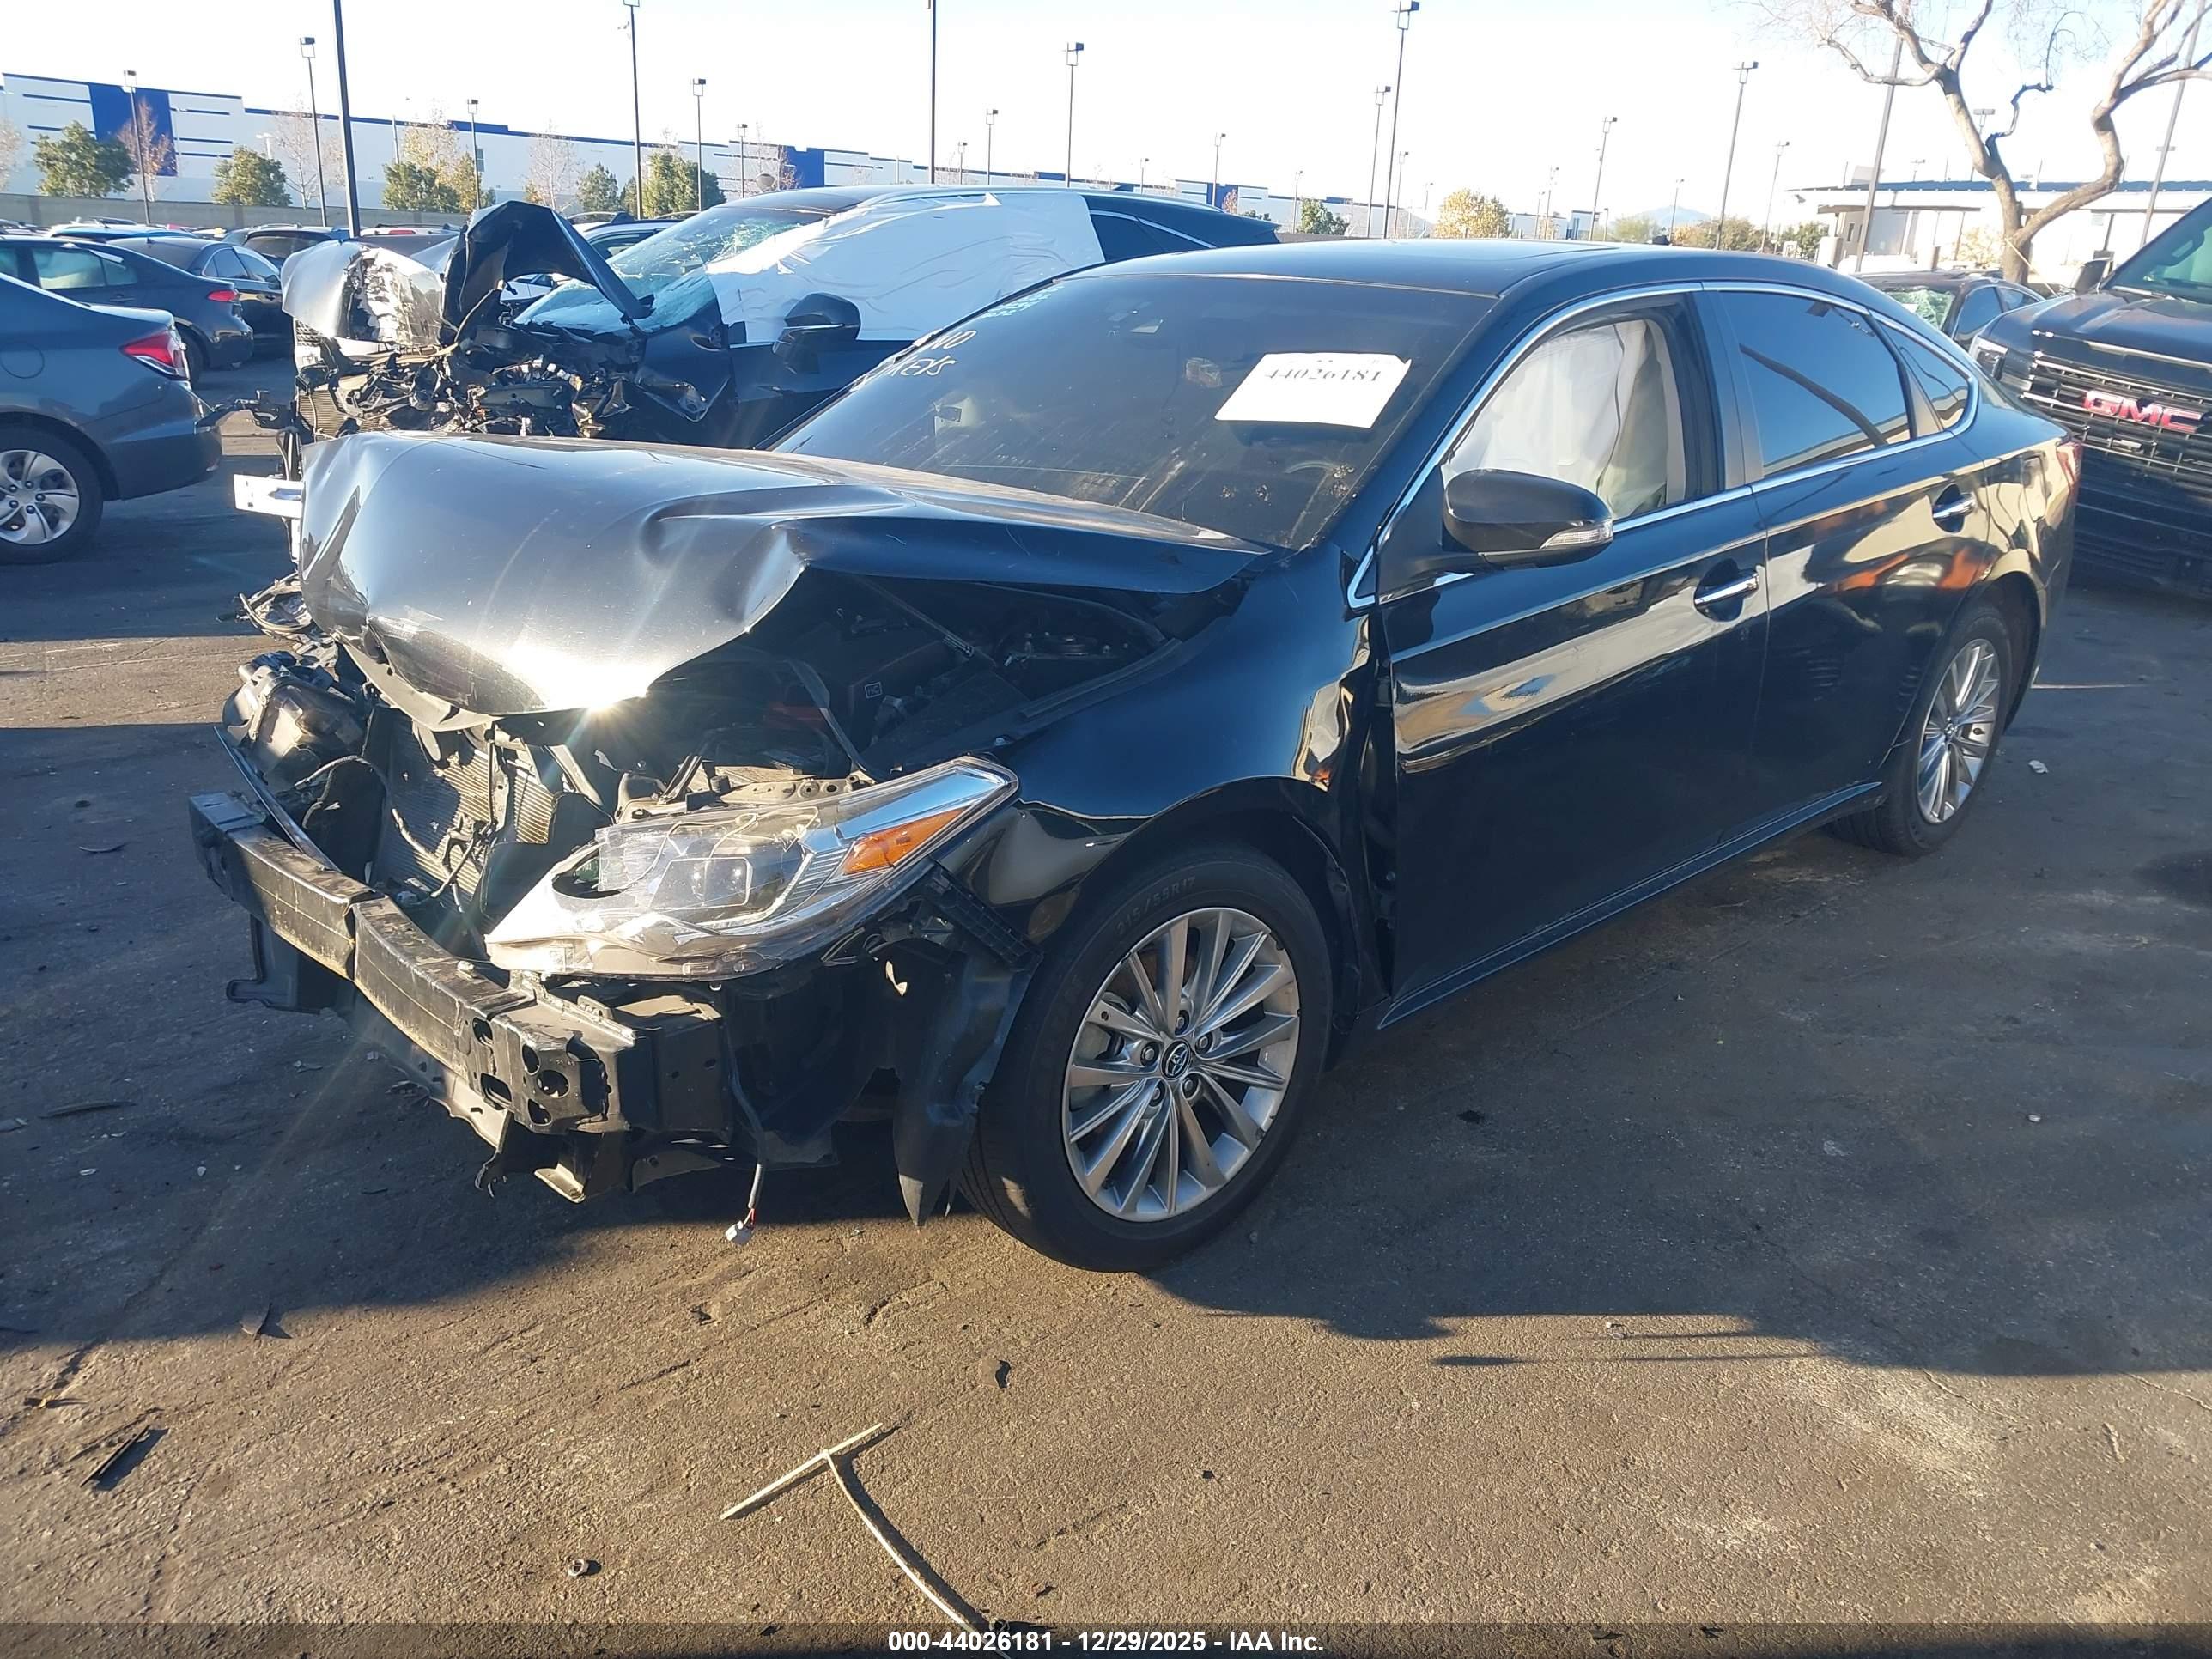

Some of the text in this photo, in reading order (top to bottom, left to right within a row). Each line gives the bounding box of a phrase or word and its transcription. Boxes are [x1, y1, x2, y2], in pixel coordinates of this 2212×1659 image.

[921, 330, 977, 350] NO
[888, 355, 957, 377] KEYS
[2083, 390, 2202, 434] GMC
